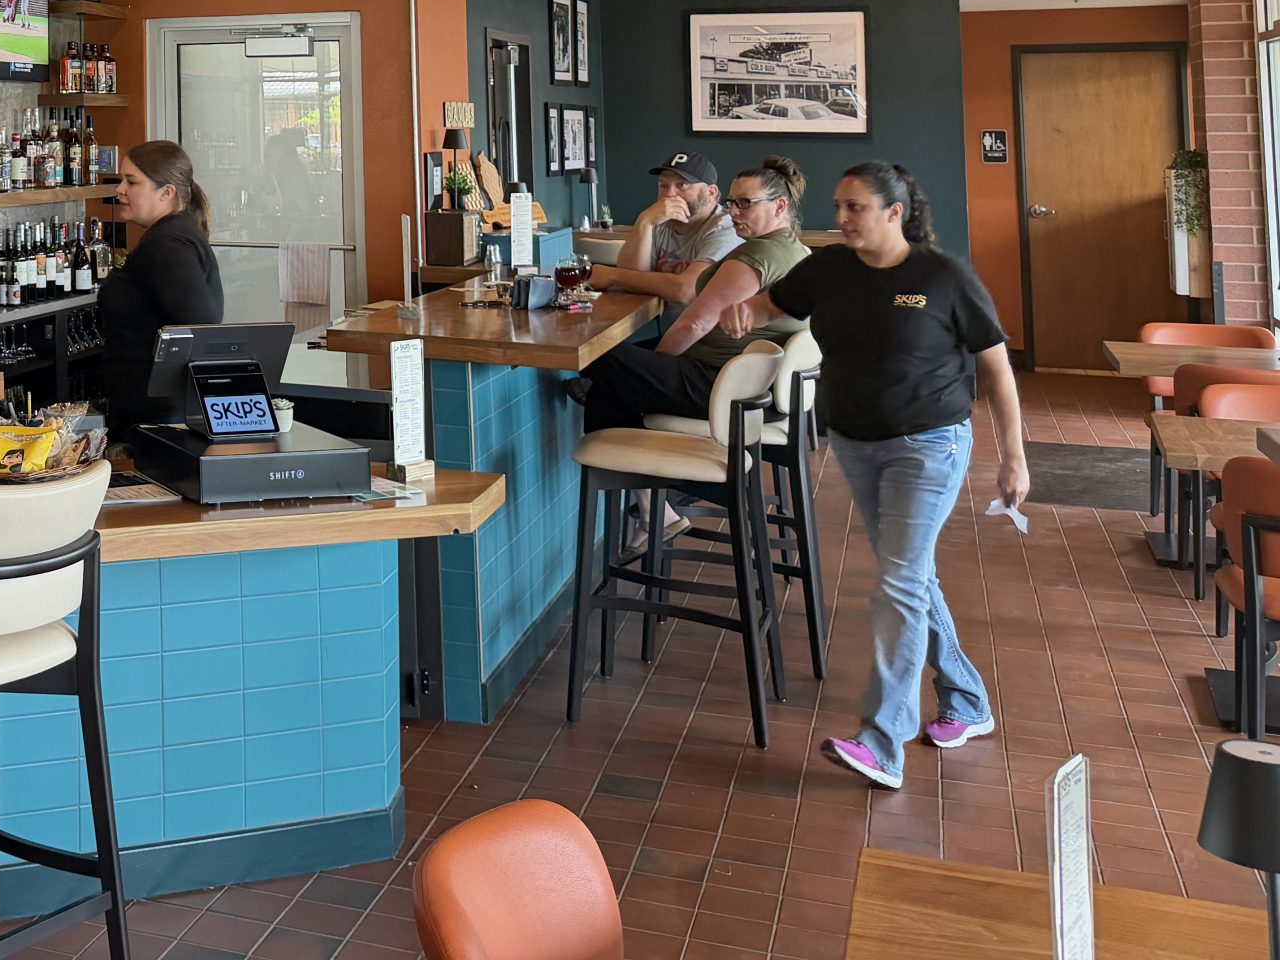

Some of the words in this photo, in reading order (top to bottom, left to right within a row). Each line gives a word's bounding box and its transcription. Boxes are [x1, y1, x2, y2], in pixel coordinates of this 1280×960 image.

[750, 63, 764, 72] COLD
[670, 153, 688, 167] P
[210, 399, 267, 421] SKIP'S
